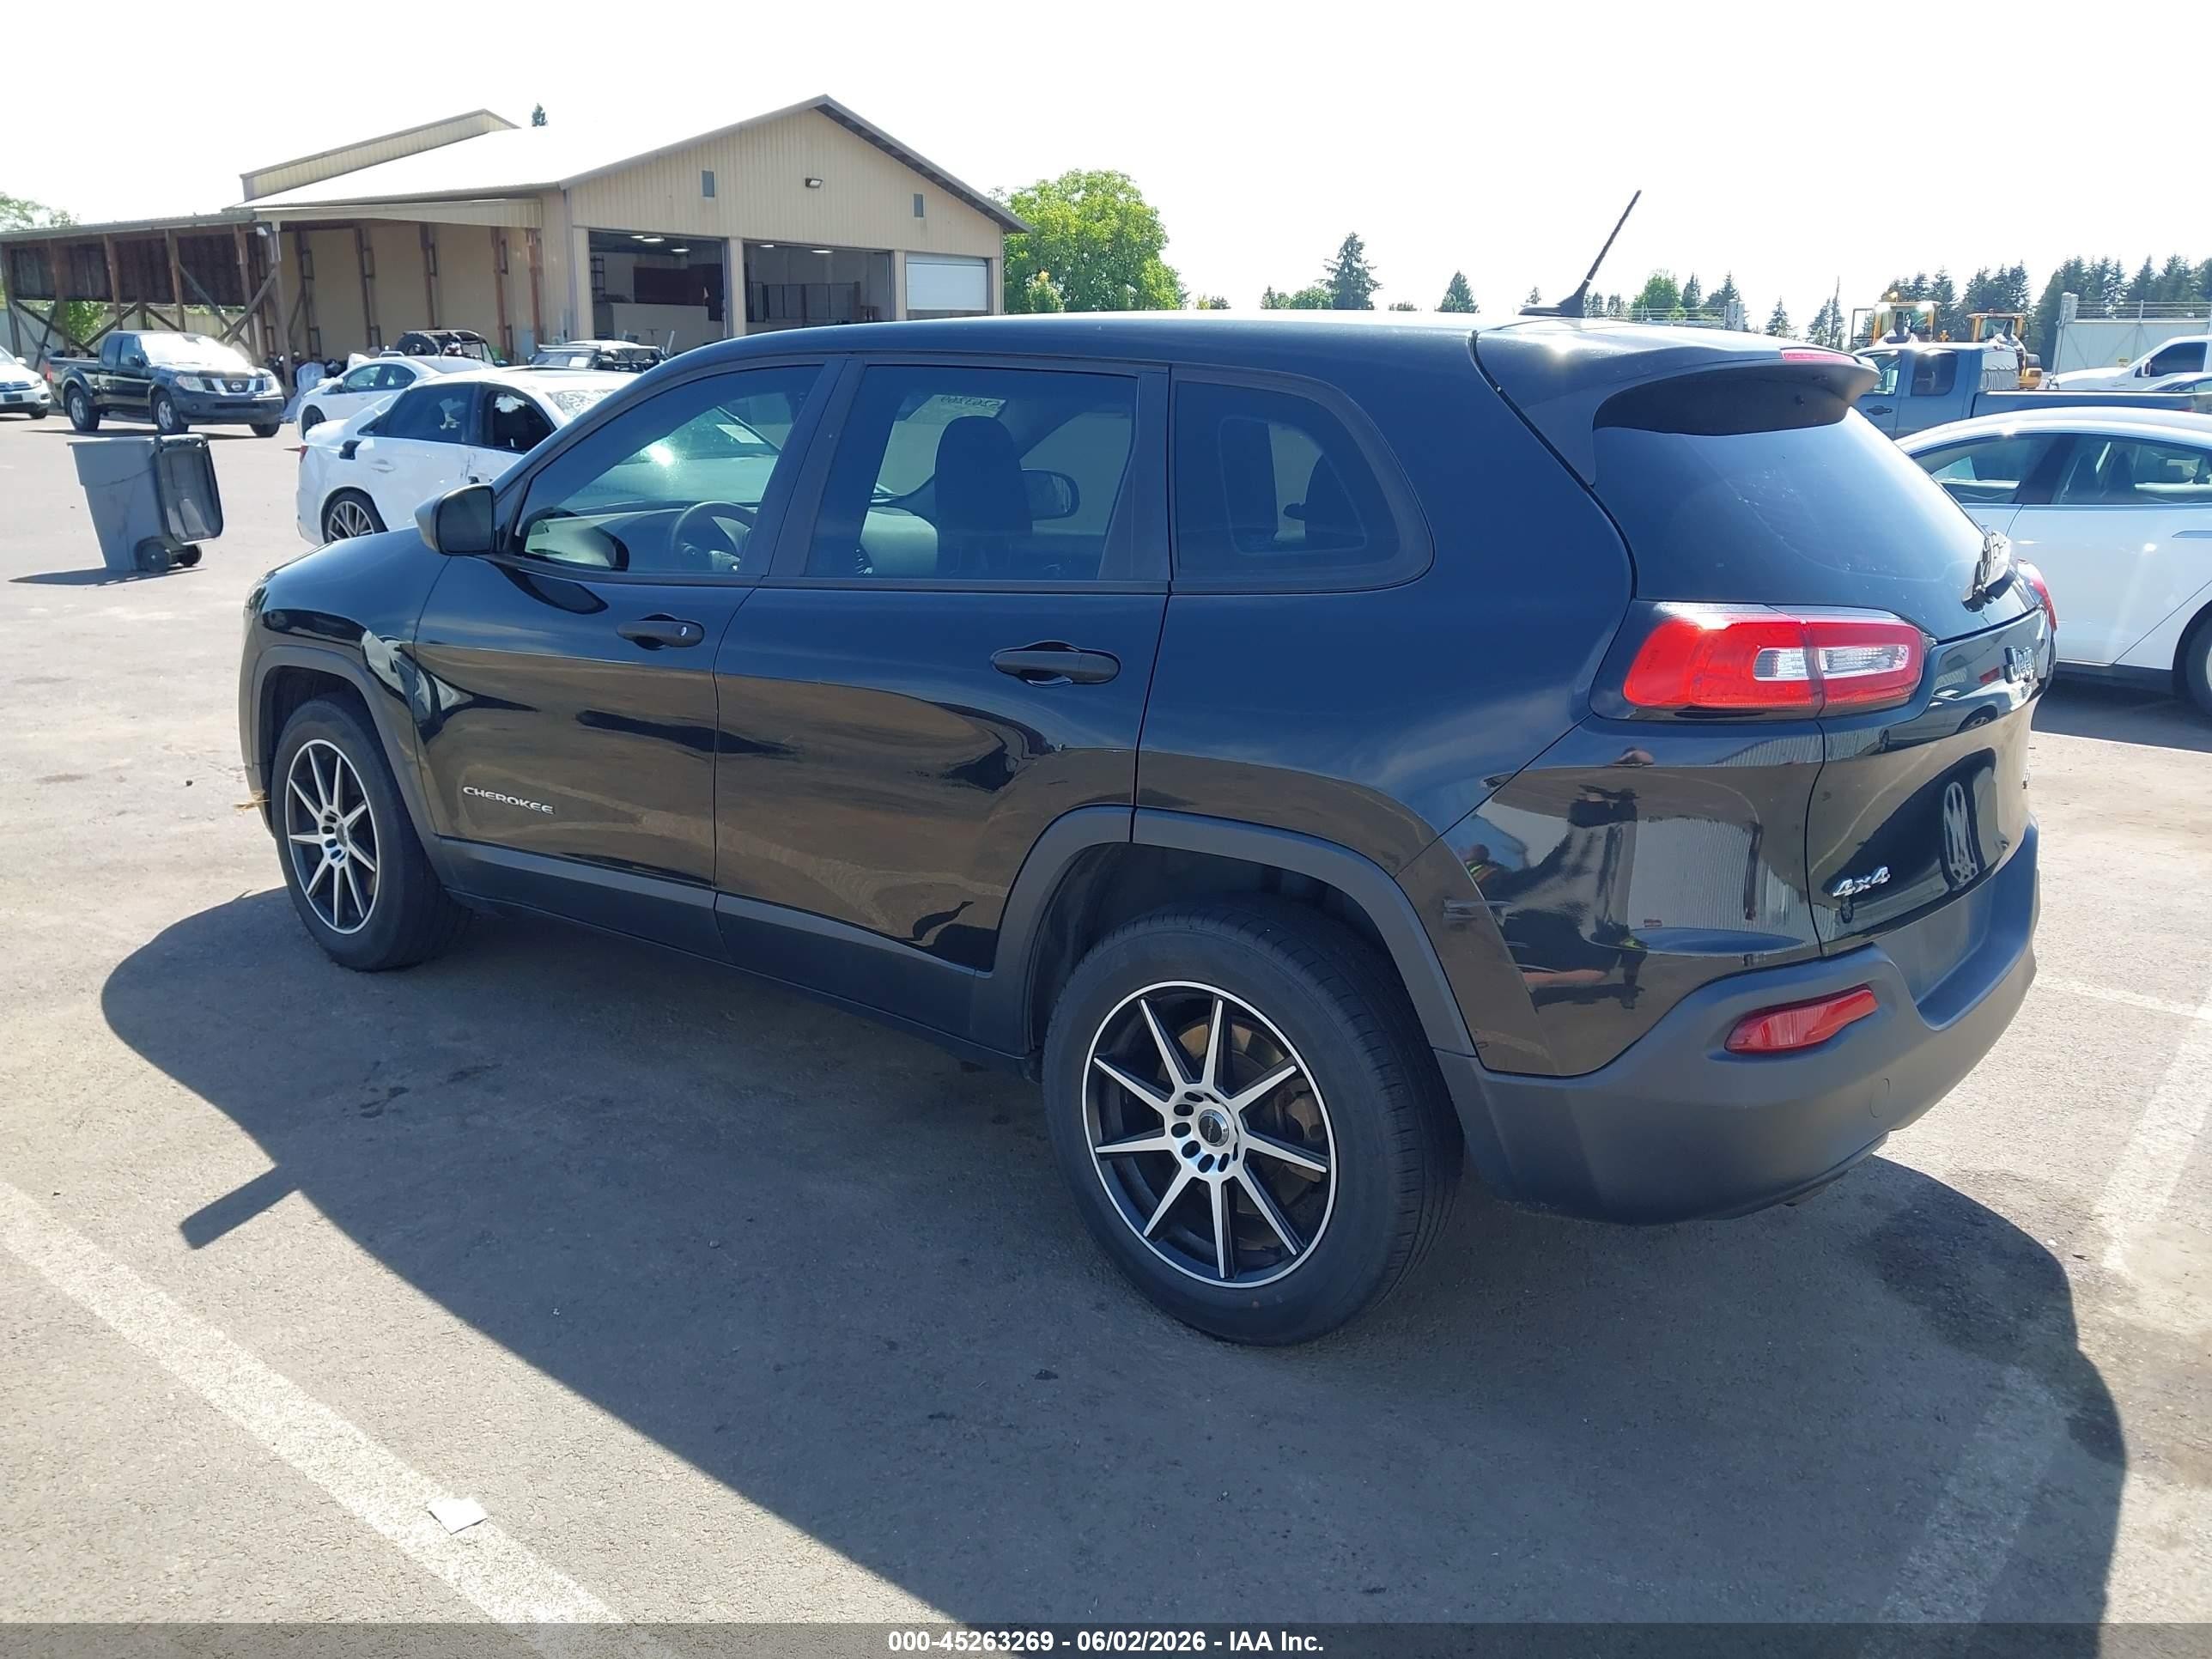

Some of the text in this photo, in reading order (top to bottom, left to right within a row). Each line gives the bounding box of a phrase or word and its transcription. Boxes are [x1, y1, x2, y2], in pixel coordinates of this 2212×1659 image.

[2003, 645, 2035, 684] Jeep
[462, 786, 555, 815] CHEROKEE
[1832, 866, 1891, 898] 4x4
